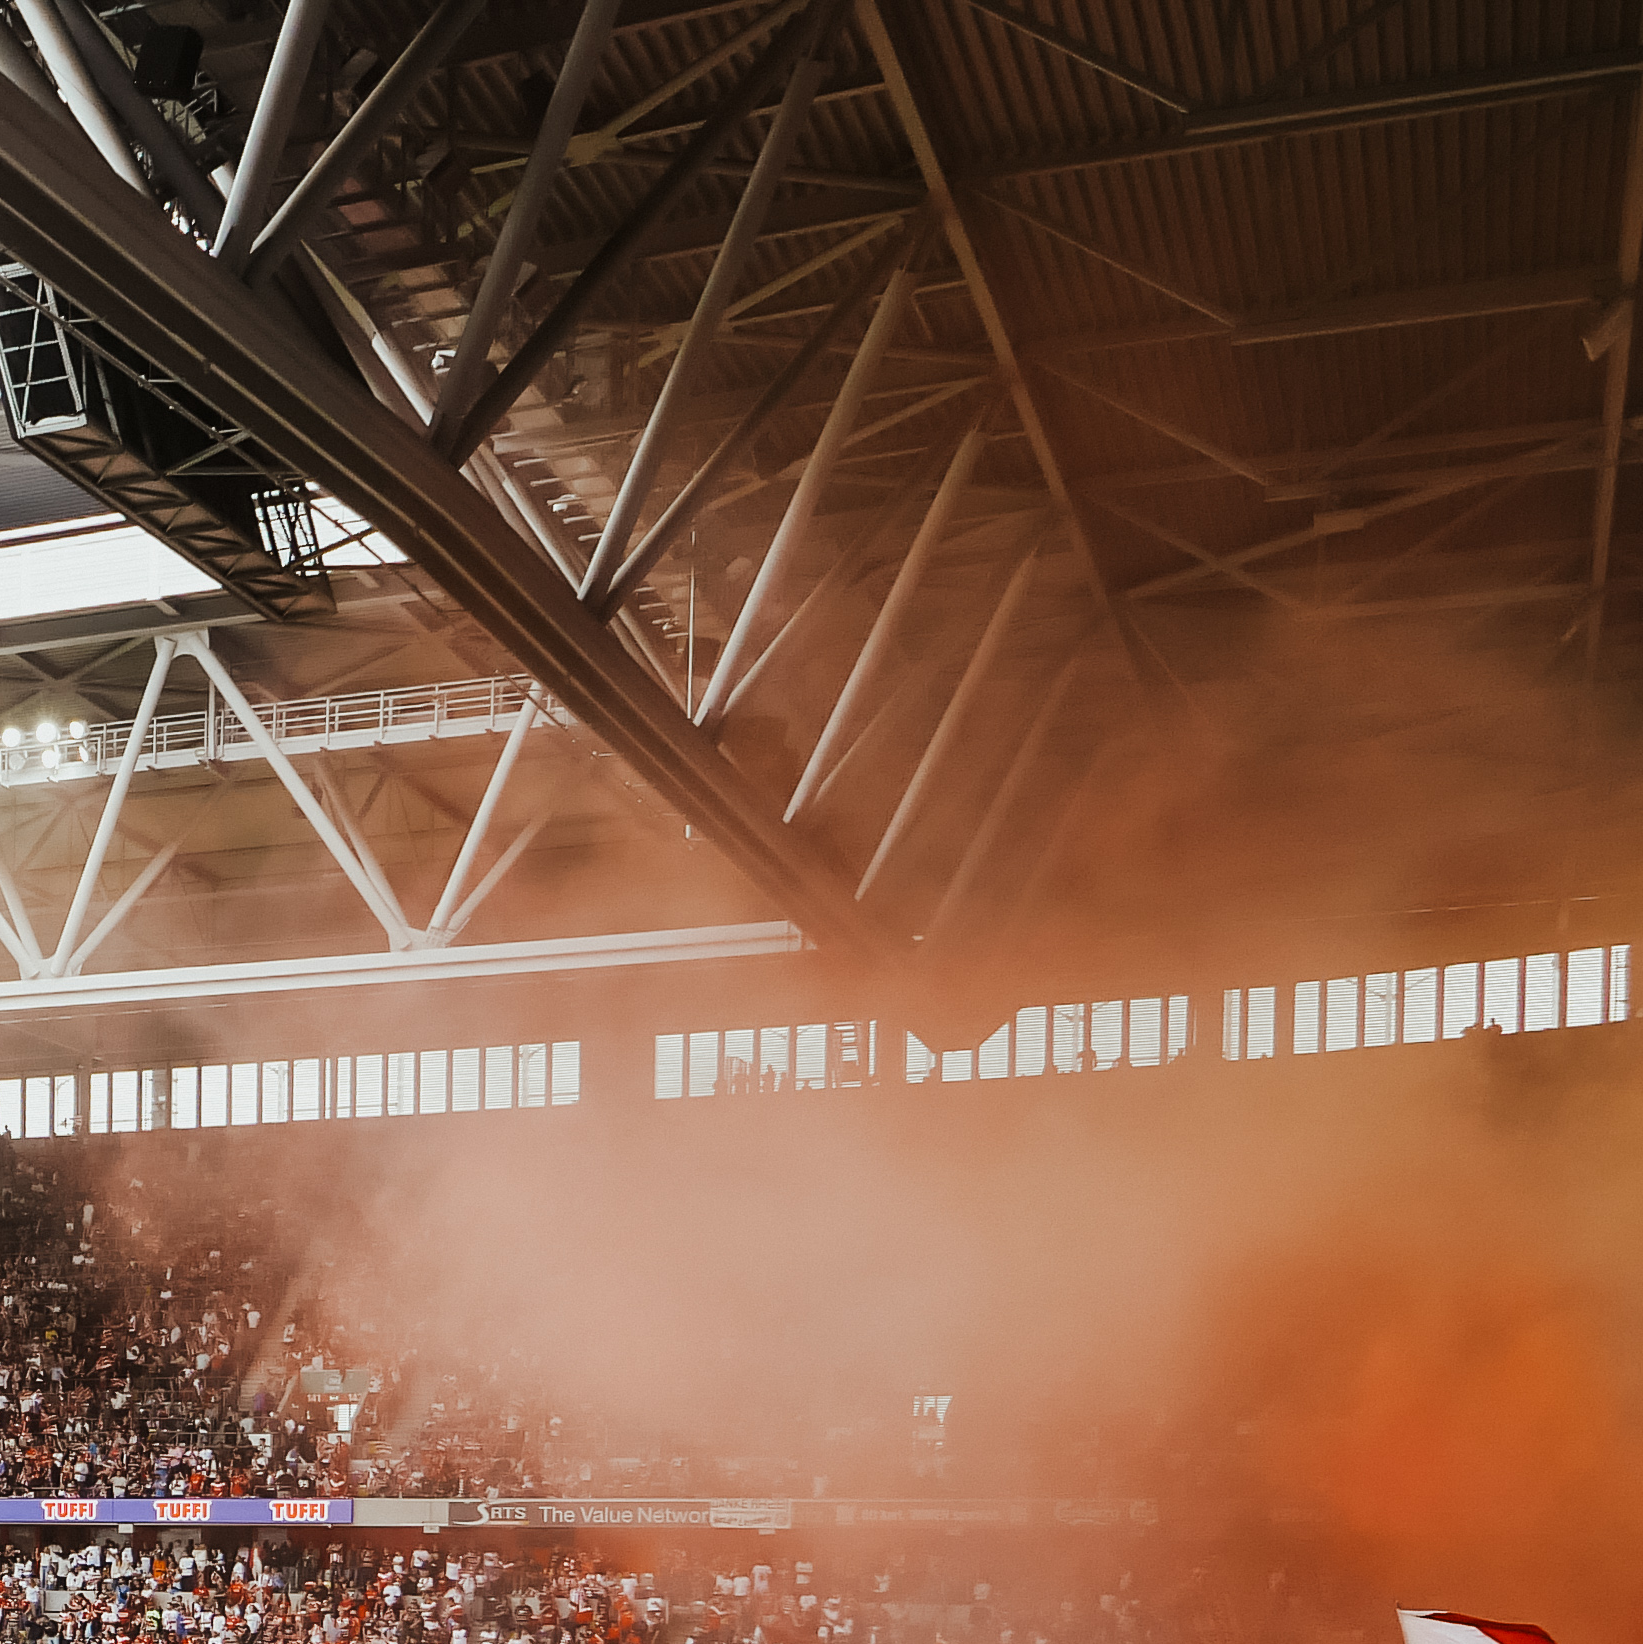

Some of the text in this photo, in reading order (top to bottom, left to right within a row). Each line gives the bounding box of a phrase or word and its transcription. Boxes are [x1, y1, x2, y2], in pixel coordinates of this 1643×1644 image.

[40, 1499, 99, 1521] TUFFI
[153, 1499, 212, 1521] TUFFI
[268, 1499, 330, 1522] TUFFI
[538, 1506, 577, 1523] The
[581, 1505, 634, 1523] Value
[637, 1506, 710, 1524] Networ
